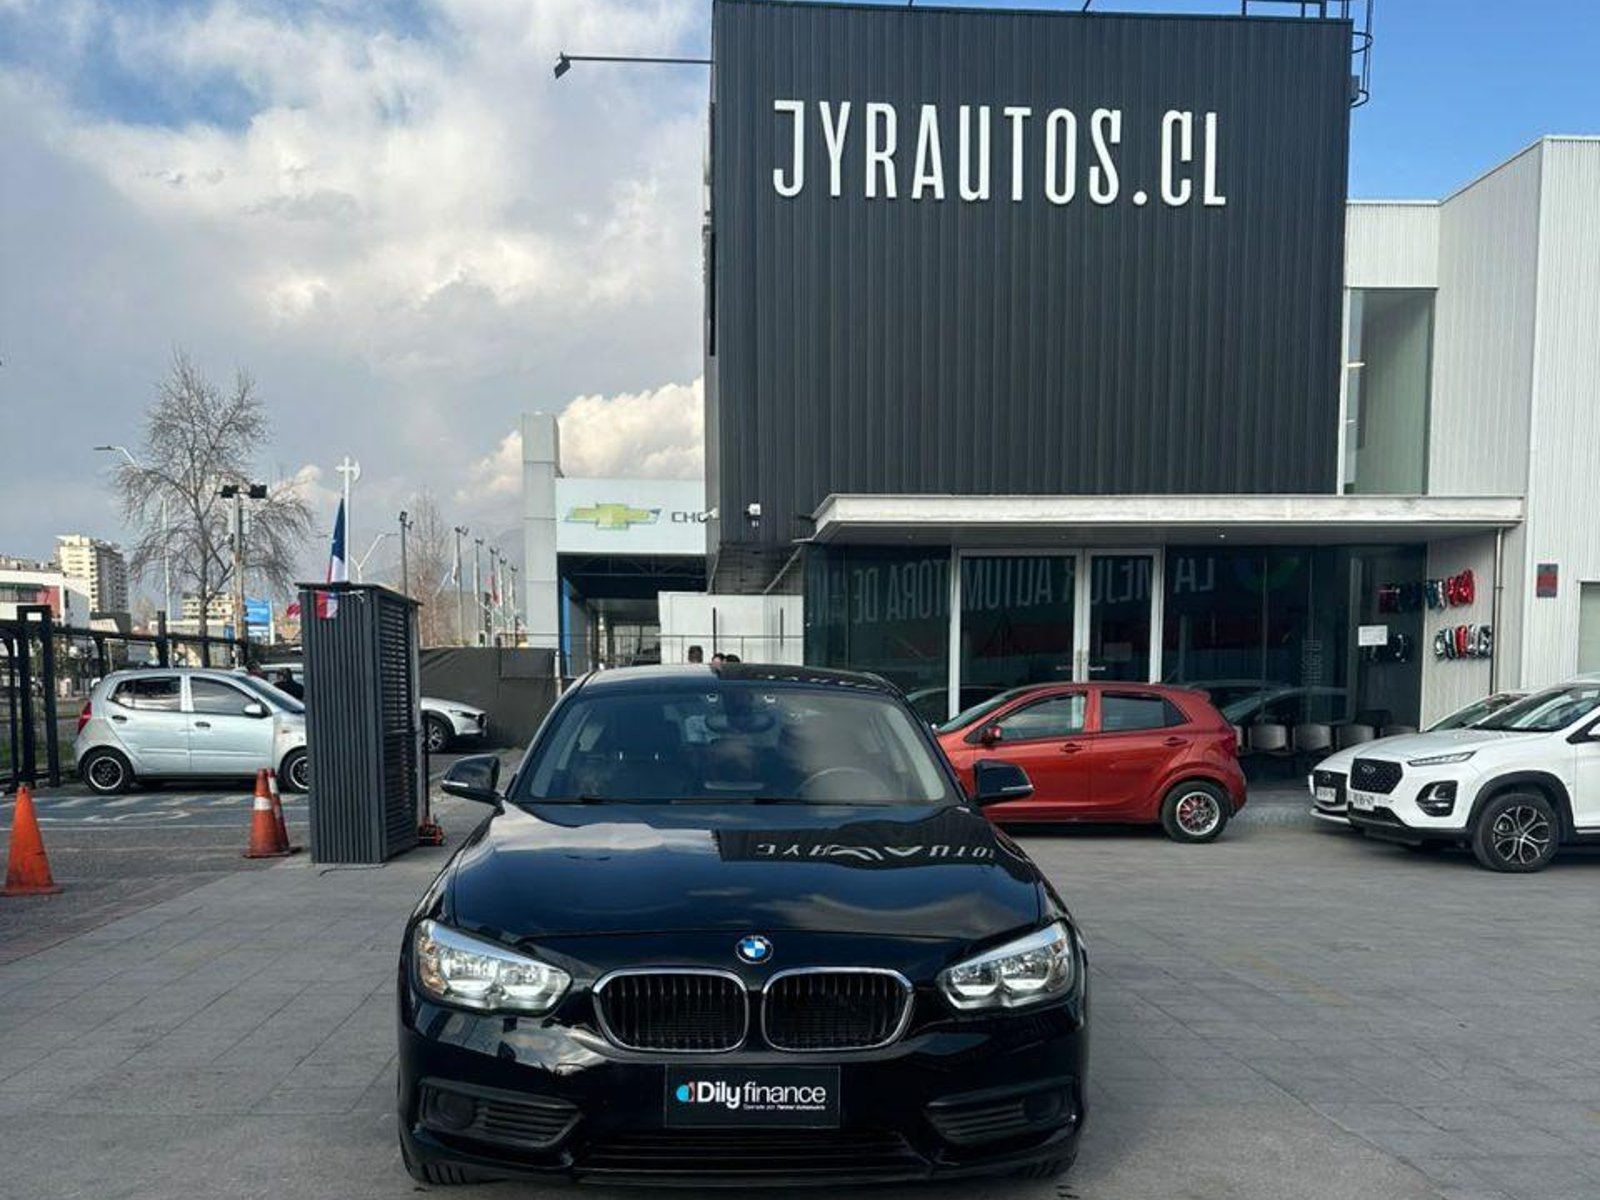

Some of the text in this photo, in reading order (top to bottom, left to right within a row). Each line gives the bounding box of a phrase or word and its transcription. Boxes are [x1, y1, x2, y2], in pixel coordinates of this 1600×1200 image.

[773, 99, 1226, 206] JYRAUTOS.CL
[697, 1081, 826, 1109] Dily finance
